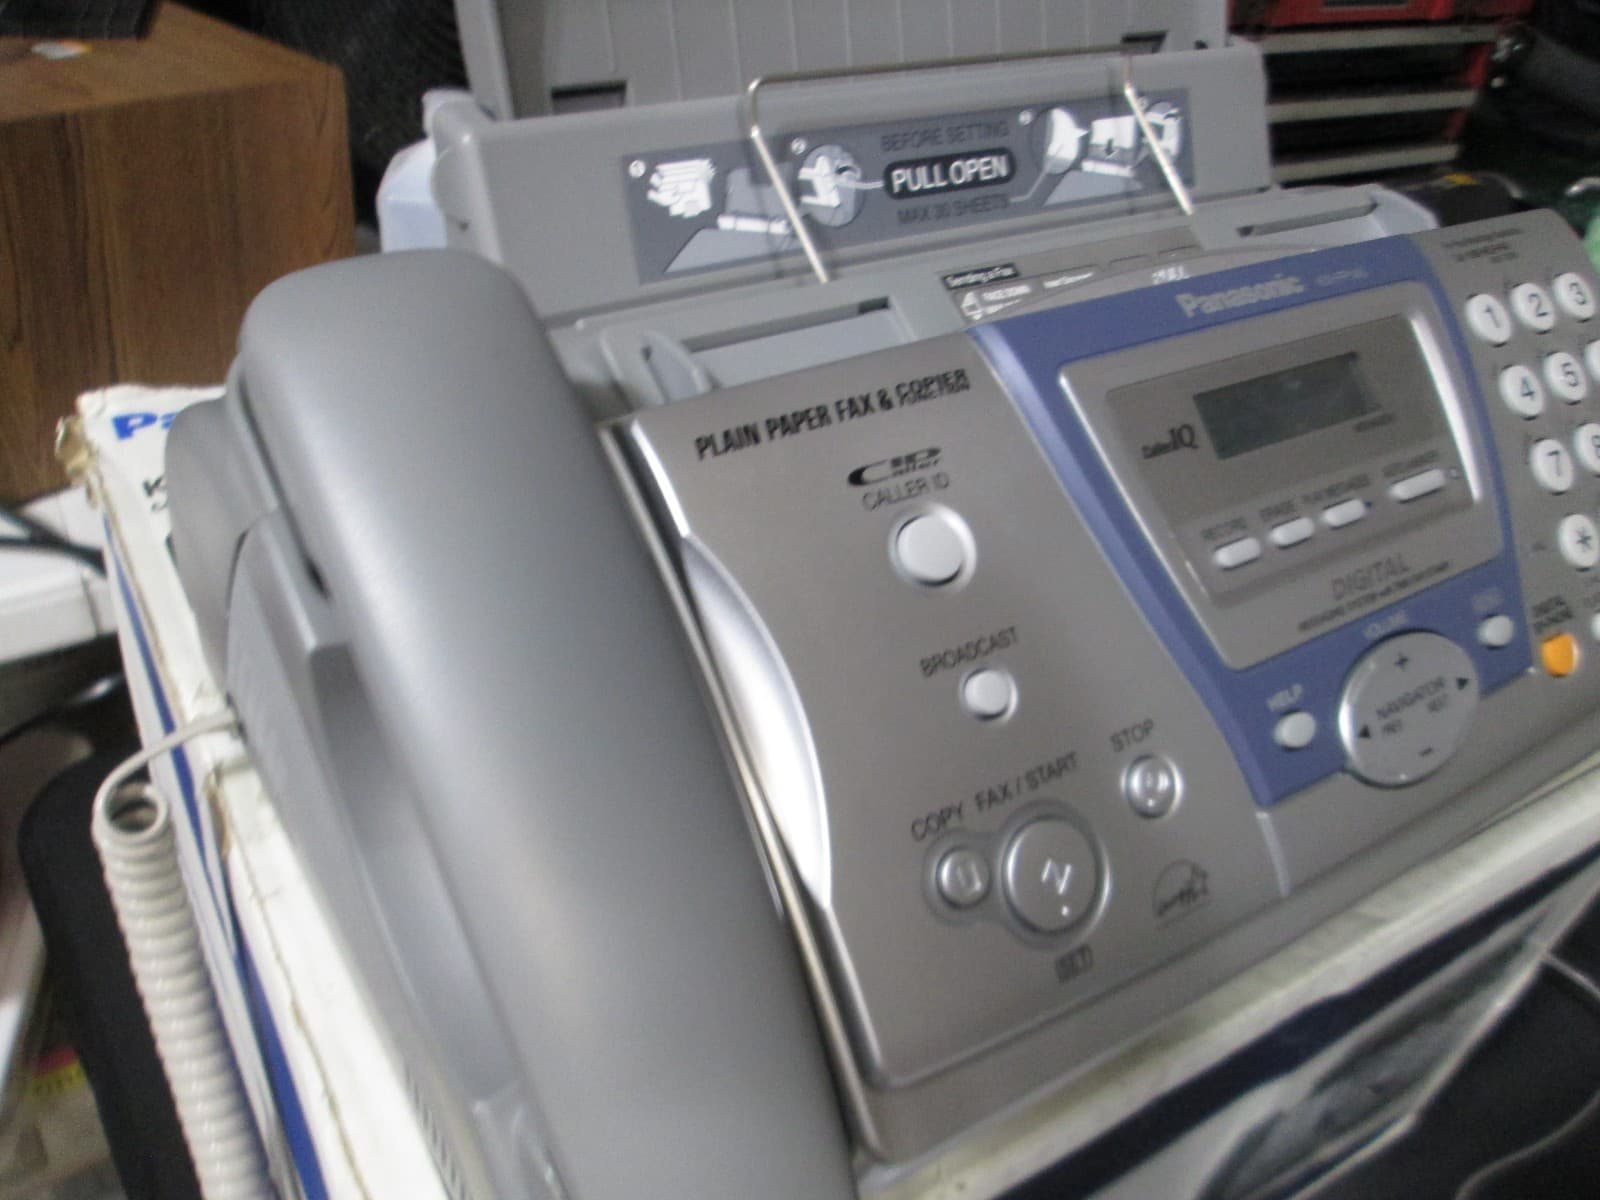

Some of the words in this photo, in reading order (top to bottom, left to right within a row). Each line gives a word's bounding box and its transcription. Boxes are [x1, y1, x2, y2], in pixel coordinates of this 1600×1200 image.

[880, 127, 943, 151] BEFORE
[946, 121, 1009, 144] SETTING
[891, 162, 948, 194] PULL
[949, 154, 1009, 184] OPEN
[1176, 273, 1304, 318] Panasonic
[1485, 304, 1501, 328] 1
[1528, 292, 1549, 317] 2
[1568, 281, 1587, 305] 3
[1521, 376, 1535, 402] 4
[1562, 362, 1579, 387] 5
[695, 423, 761, 460] PLAIN
[766, 406, 832, 442] PAPER
[834, 392, 875, 424] FAX
[876, 389, 894, 411] &
[1547, 450, 1561, 477] 7
[862, 478, 929, 512] CALLER
[932, 471, 950, 490] ID
[1332, 553, 1410, 599] DIGITAL
[920, 626, 1019, 678] BROADCAST
[1109, 719, 1155, 754] STOP
[975, 782, 1011, 812] FAX
[1025, 751, 1078, 791] START
[911, 801, 964, 842] COPY
